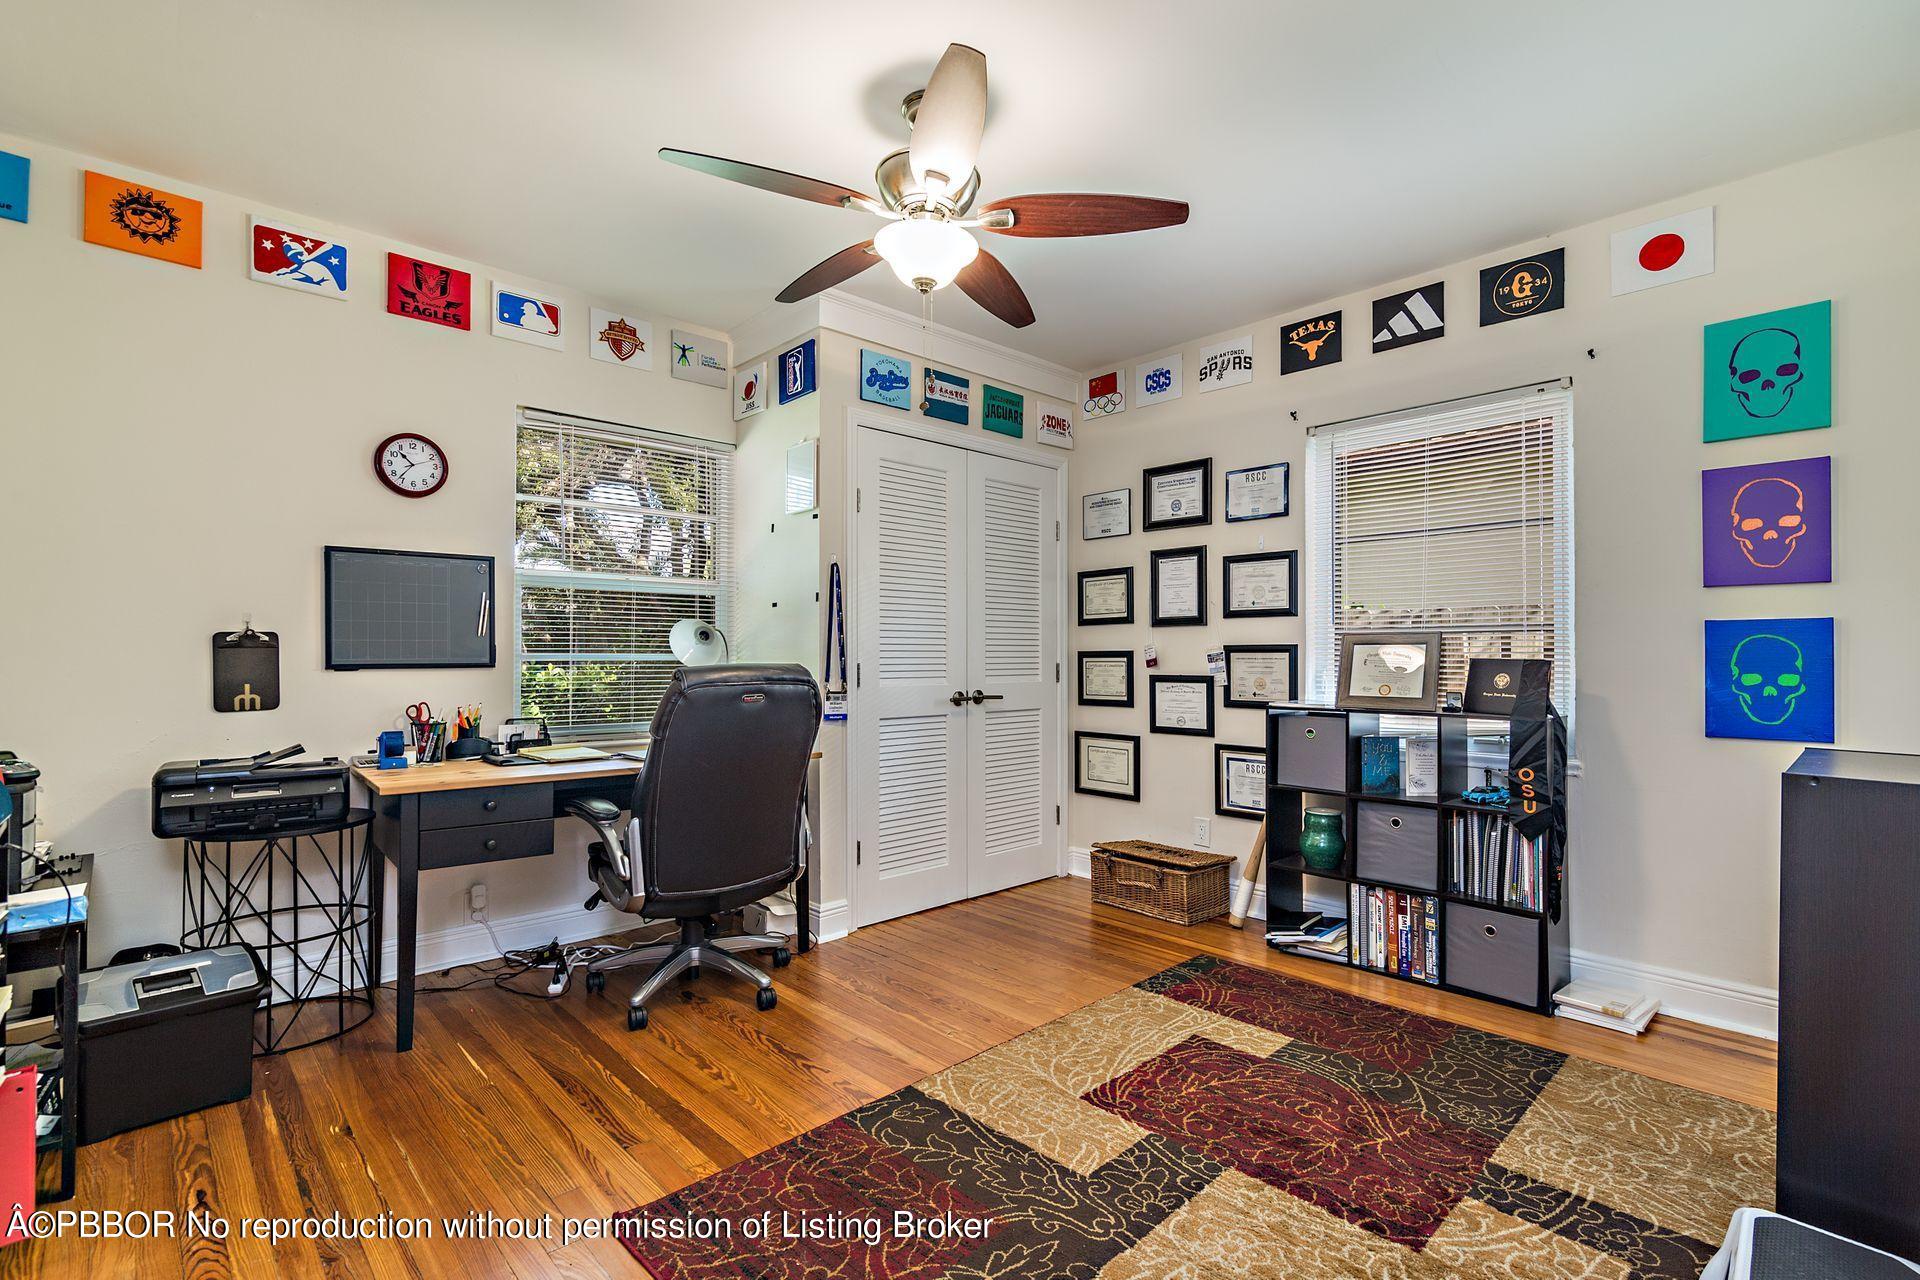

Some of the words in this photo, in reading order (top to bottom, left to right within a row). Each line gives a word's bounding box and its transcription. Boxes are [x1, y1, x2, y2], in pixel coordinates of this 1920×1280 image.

[1499, 286, 1510, 295] 19
[1511, 271, 1533, 298] G
[1534, 276, 1548, 286] 34
[399, 300, 462, 325] EAGLES
[1289, 320, 1336, 341] TEXAS
[1206, 354, 1218, 364] SAN
[1218, 349, 1245, 359] ANTONIO
[875, 358, 903, 374] YOKOHAMA
[1199, 356, 1252, 382] SPURS
[1145, 369, 1172, 392] CSCS
[875, 389, 901, 403] BASEBALL
[985, 403, 1024, 426] JAGUARS
[1046, 414, 1067, 431] ZONE
[389, 450, 399, 458] 10
[408, 442, 417, 450] 12
[429, 453, 435, 461] 2
[1245, 471, 1267, 483] RSCC
[1246, 763, 1266, 775] RSCC
[1517, 766, 1538, 815] OSU
